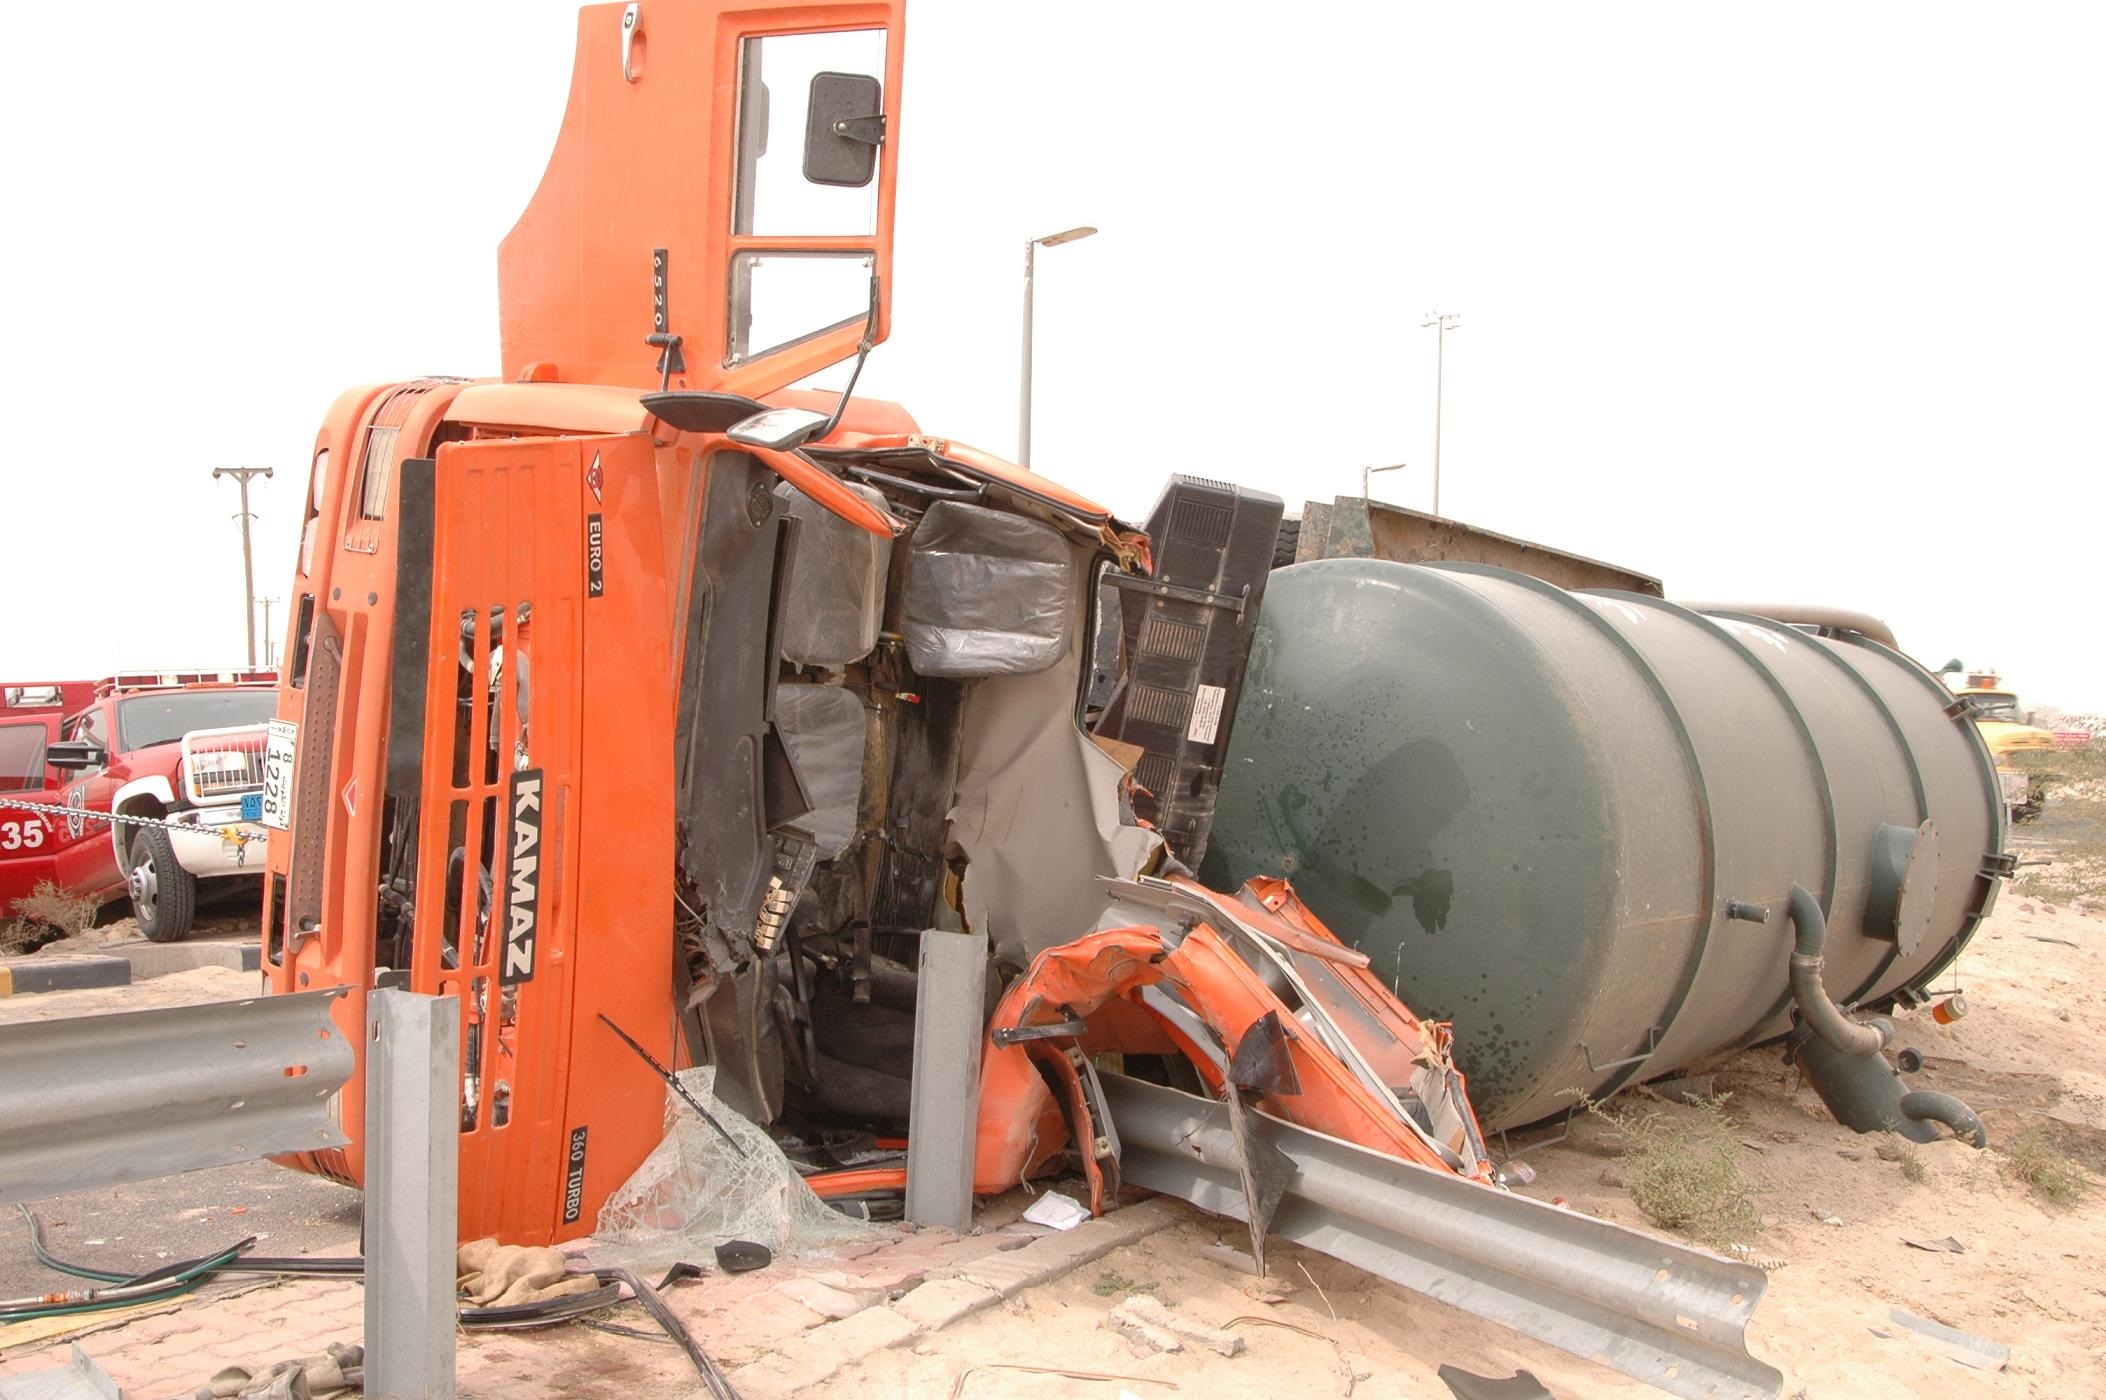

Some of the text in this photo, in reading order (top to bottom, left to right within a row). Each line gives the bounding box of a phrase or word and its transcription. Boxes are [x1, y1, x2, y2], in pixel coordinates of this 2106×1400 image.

[654, 256, 663, 326] 6520
[589, 521, 602, 592] EURO 2
[264, 747, 281, 815] 1228
[283, 752, 292, 764] 8
[0, 820, 44, 850] 35
[506, 779, 540, 977] KAMAZ
[564, 1131, 586, 1219] 360 TURBO
